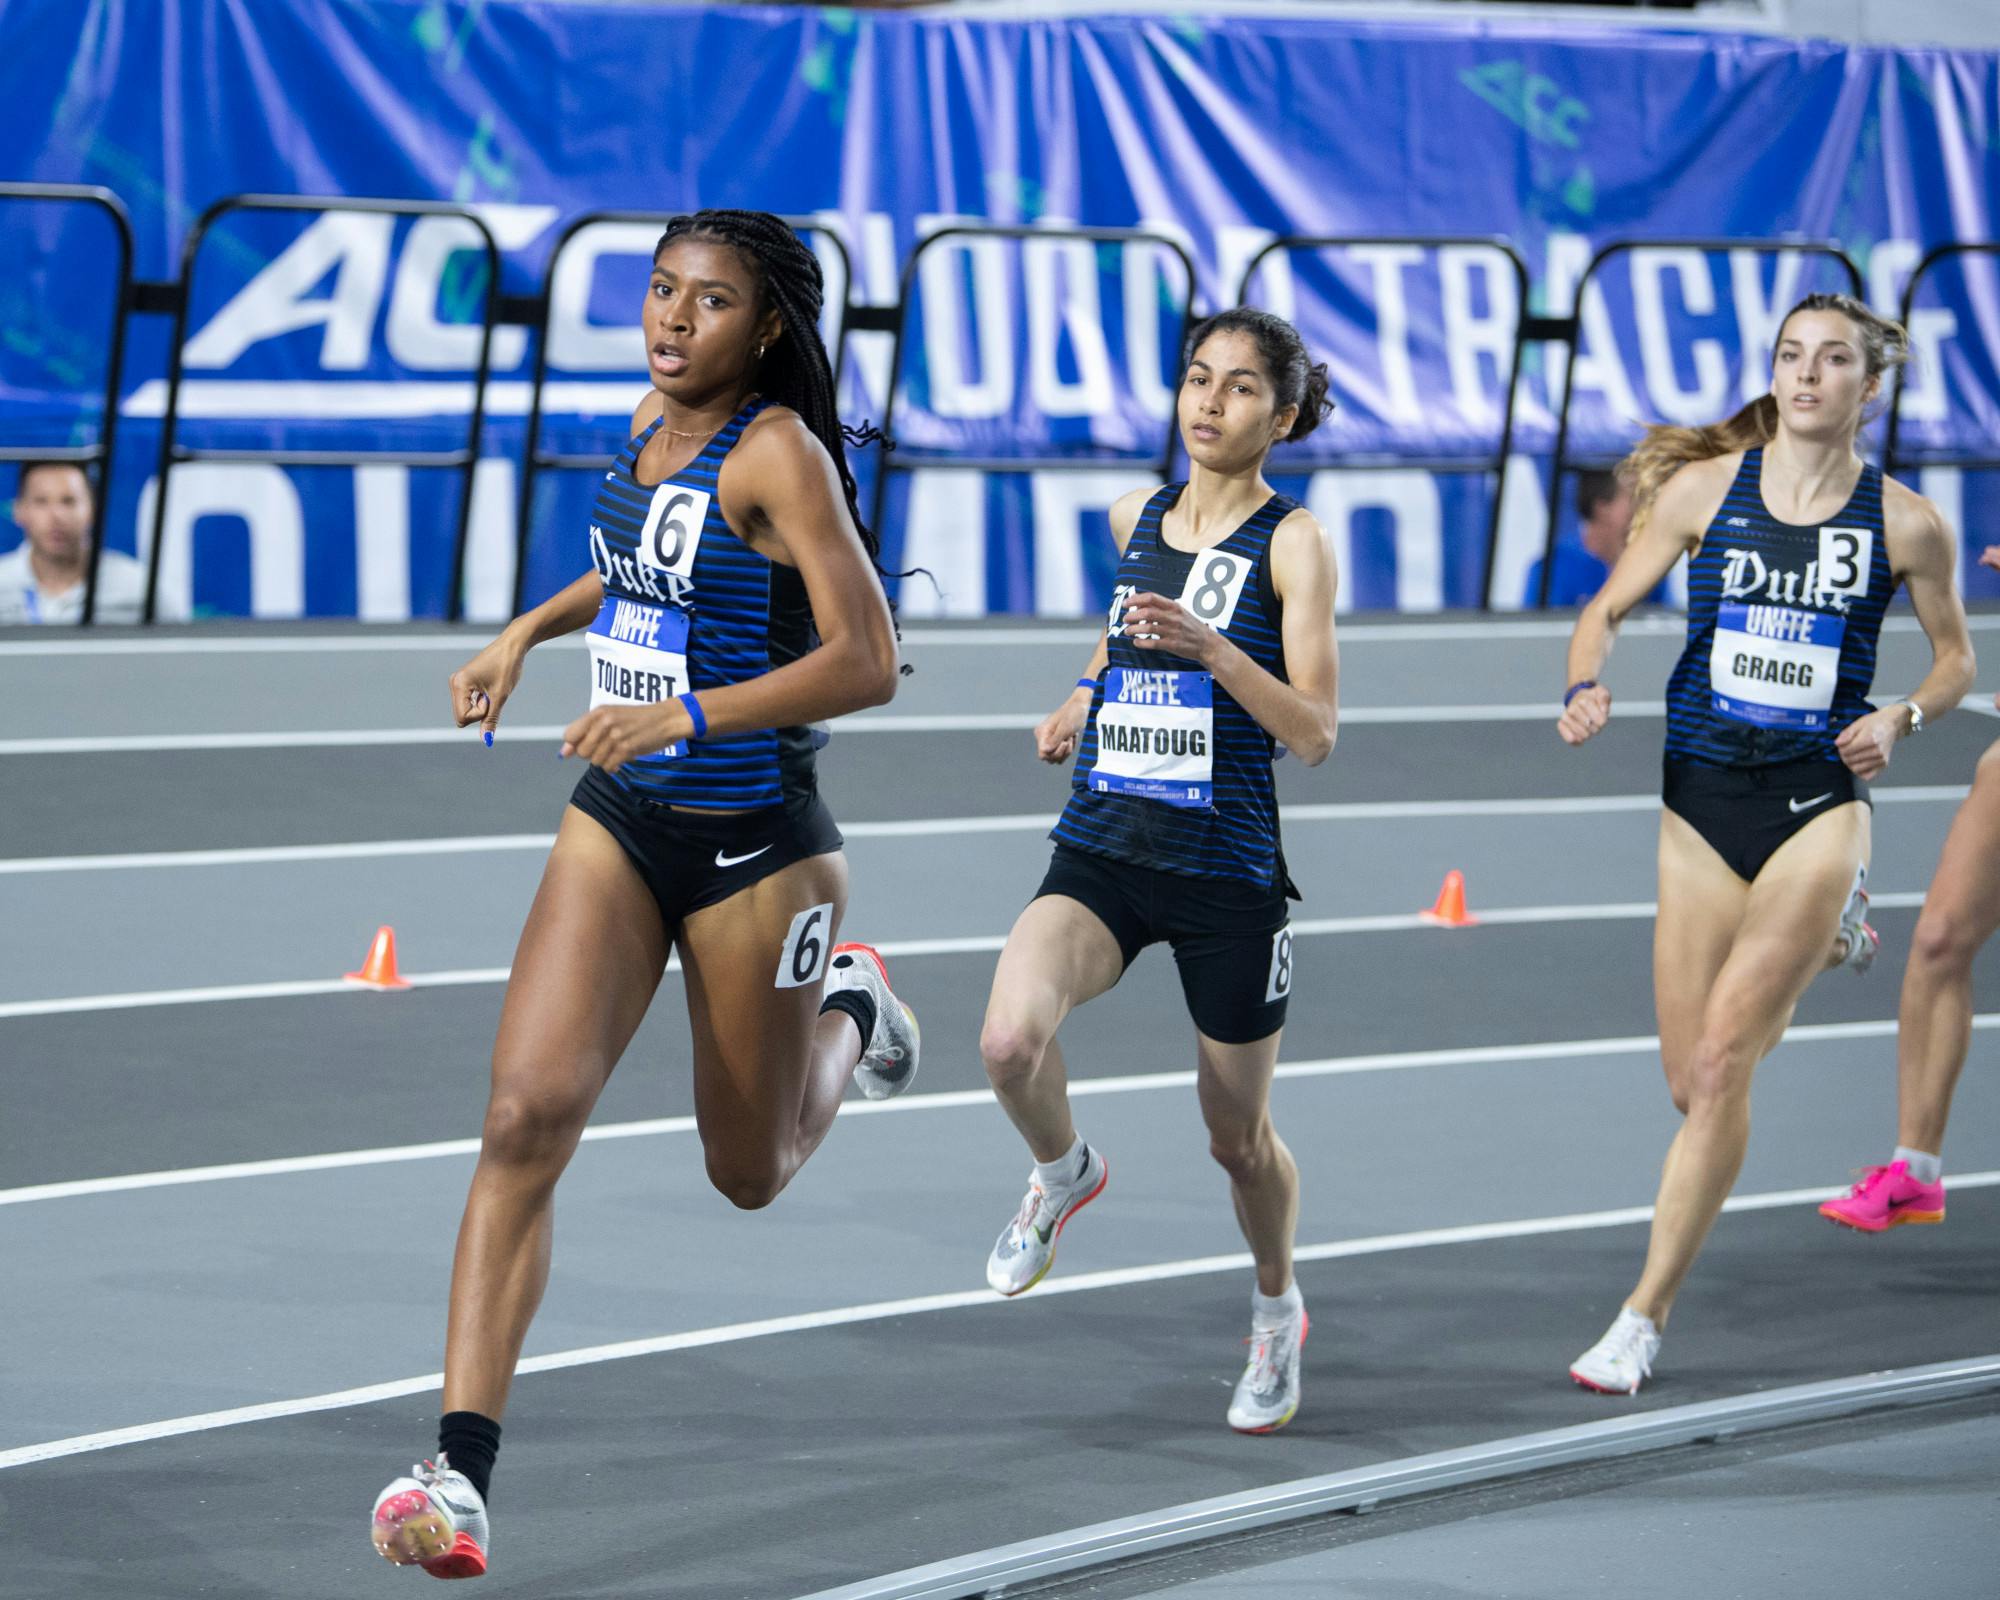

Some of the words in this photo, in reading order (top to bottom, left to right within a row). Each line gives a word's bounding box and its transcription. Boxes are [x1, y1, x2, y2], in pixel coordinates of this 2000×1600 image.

[1347, 230, 1800, 422] TRACK
[654, 493, 694, 567] 6
[1193, 556, 1236, 619] 8
[1830, 533, 1859, 589] 3
[609, 600, 663, 648] UNITE
[1746, 604, 1816, 643] UNITE
[597, 658, 676, 702] TOLBERT
[1732, 653, 1814, 688] GRAGG
[1101, 723, 1206, 757] MAATOUG
[792, 911, 821, 982] 6
[1275, 930, 1290, 993] 8
